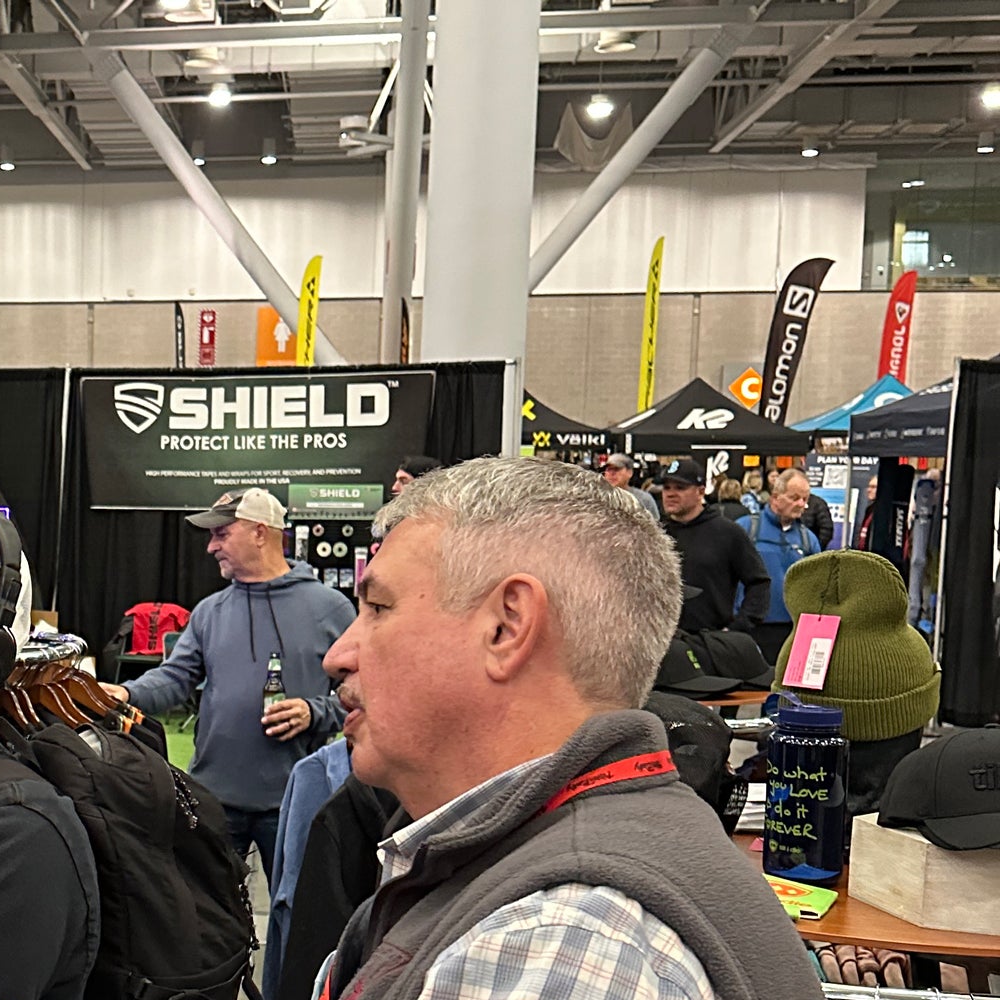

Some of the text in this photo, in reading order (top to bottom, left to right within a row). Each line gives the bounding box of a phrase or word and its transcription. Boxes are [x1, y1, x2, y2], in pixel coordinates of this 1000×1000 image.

[765, 322, 803, 424] alomon
[168, 383, 391, 430] SHIELD
[677, 408, 735, 430] K2
[160, 433, 348, 451] PROTECT LIKE THE PROS
[817, 455, 838, 464] PLAN
[861, 456, 879, 465] DAY
[319, 488, 361, 498] SHIELD
[784, 766, 827, 782] what
[769, 779, 829, 801] you LOVE
[775, 801, 808, 819] do it
[765, 819, 818, 841] OREVER
